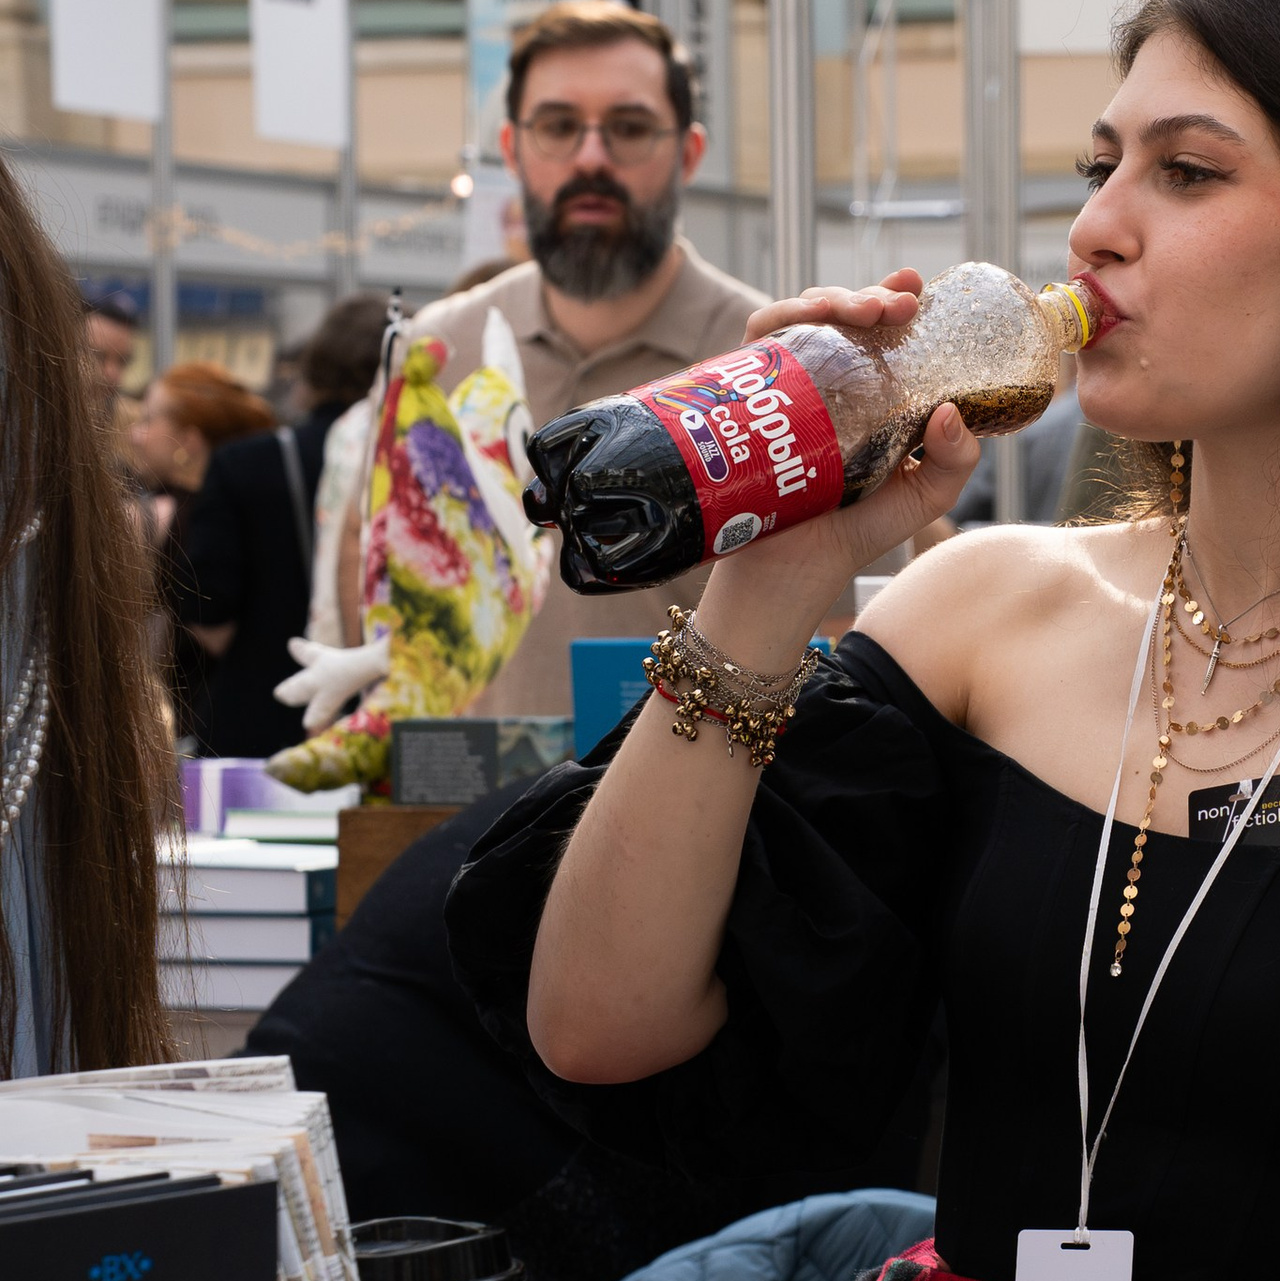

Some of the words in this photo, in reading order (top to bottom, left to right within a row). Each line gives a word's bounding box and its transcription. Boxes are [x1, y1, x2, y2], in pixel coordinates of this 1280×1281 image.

[709, 355, 816, 498] Добрый
[710, 405, 750, 464] cola
[697, 441, 712, 463] SOUND
[704, 439, 720, 458] JAZZ
[1197, 805, 1230, 821] non
